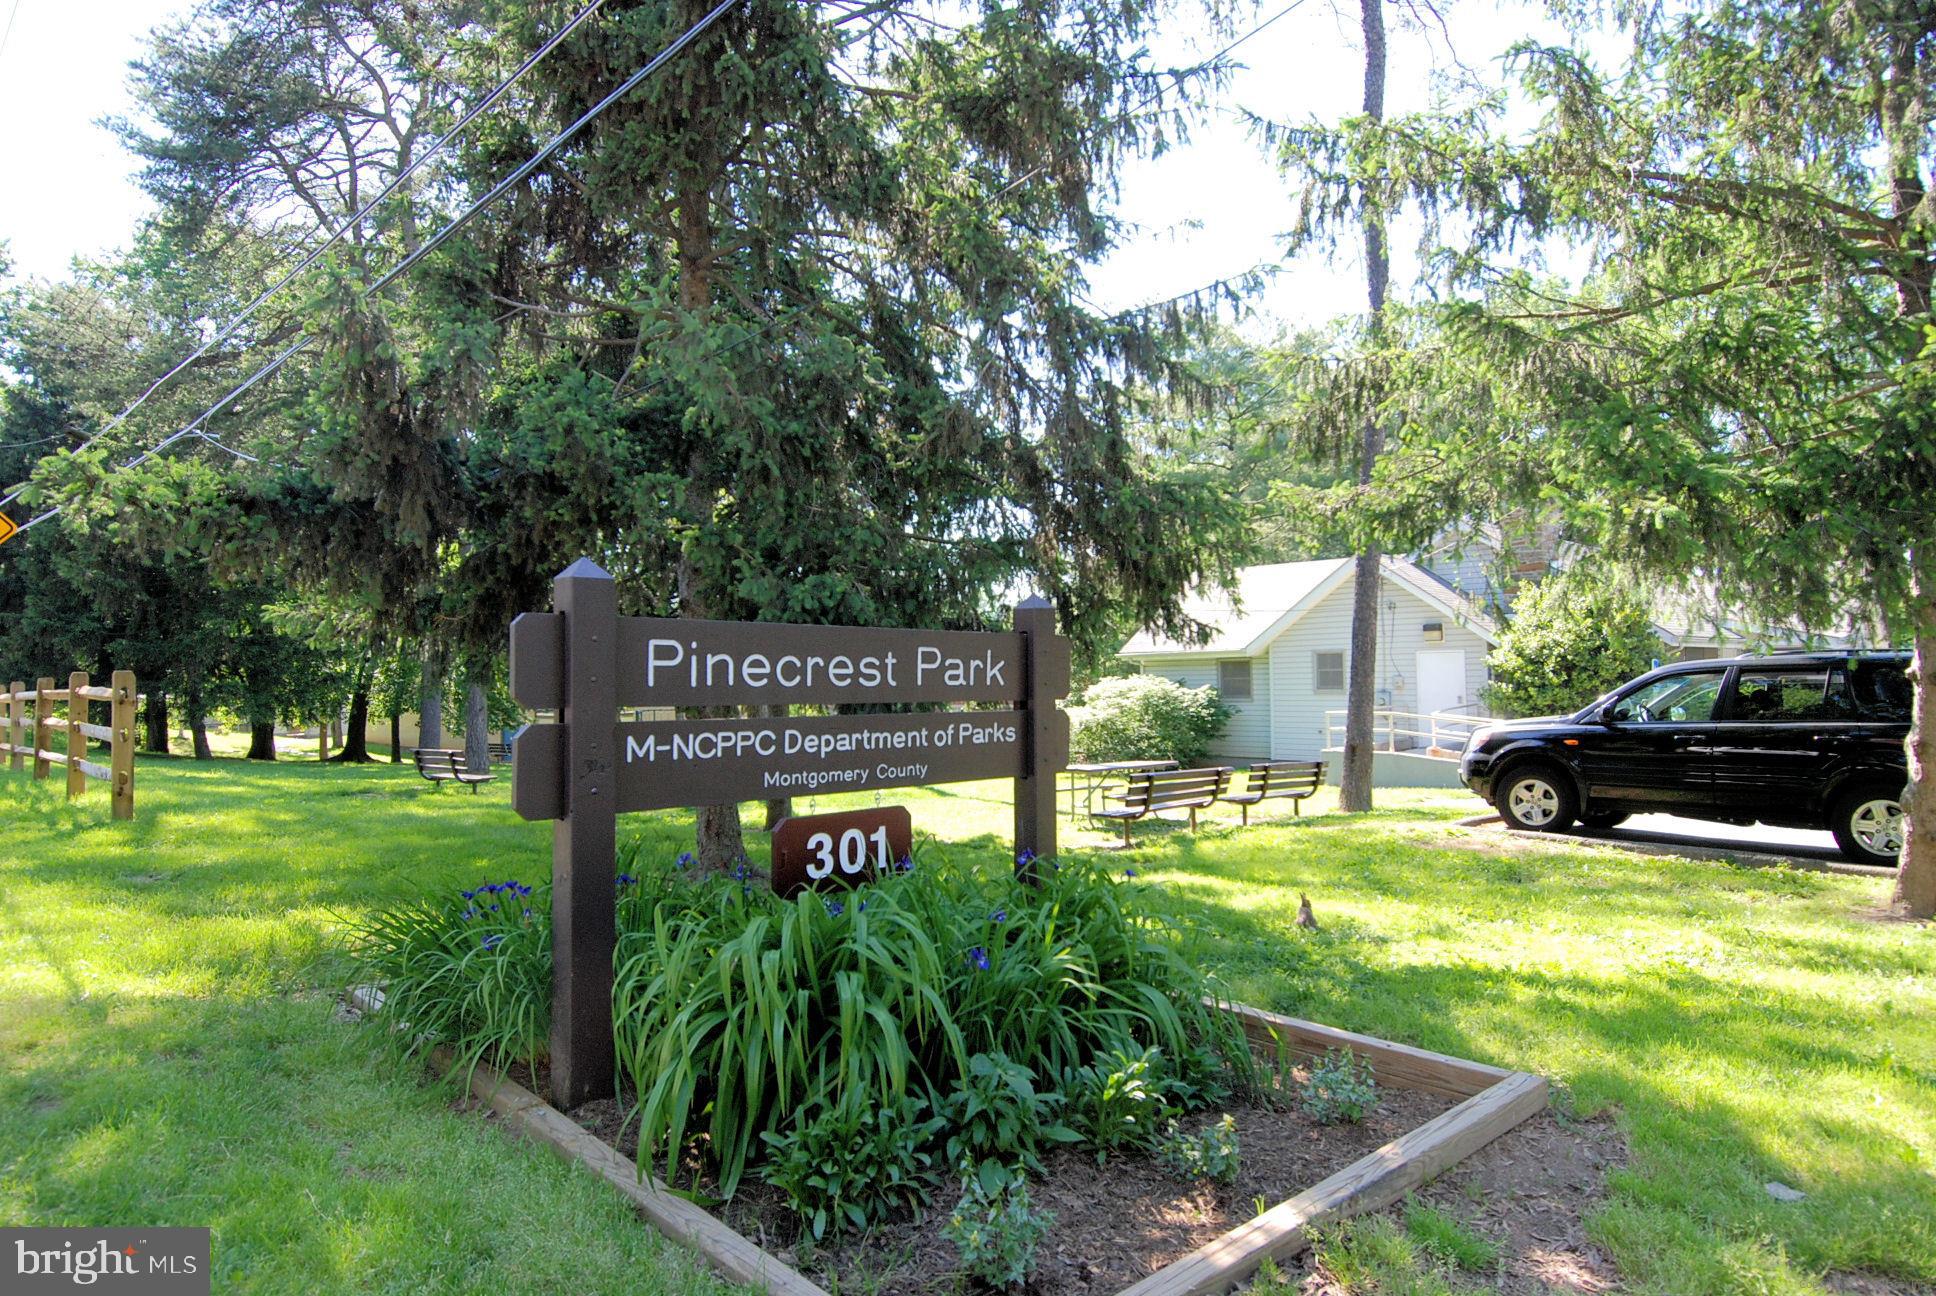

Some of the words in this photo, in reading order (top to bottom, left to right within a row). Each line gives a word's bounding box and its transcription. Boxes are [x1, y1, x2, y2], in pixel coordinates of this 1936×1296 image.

[647, 638, 897, 688] Pinecrest
[916, 646, 1006, 686] Park
[626, 729, 776, 763] M-NCPPC
[784, 727, 929, 759] Department
[933, 723, 956, 747] of
[958, 721, 1017, 745] Parks
[763, 768, 869, 789] Montgomery
[876, 762, 929, 780] County
[805, 825, 887, 880] 301
